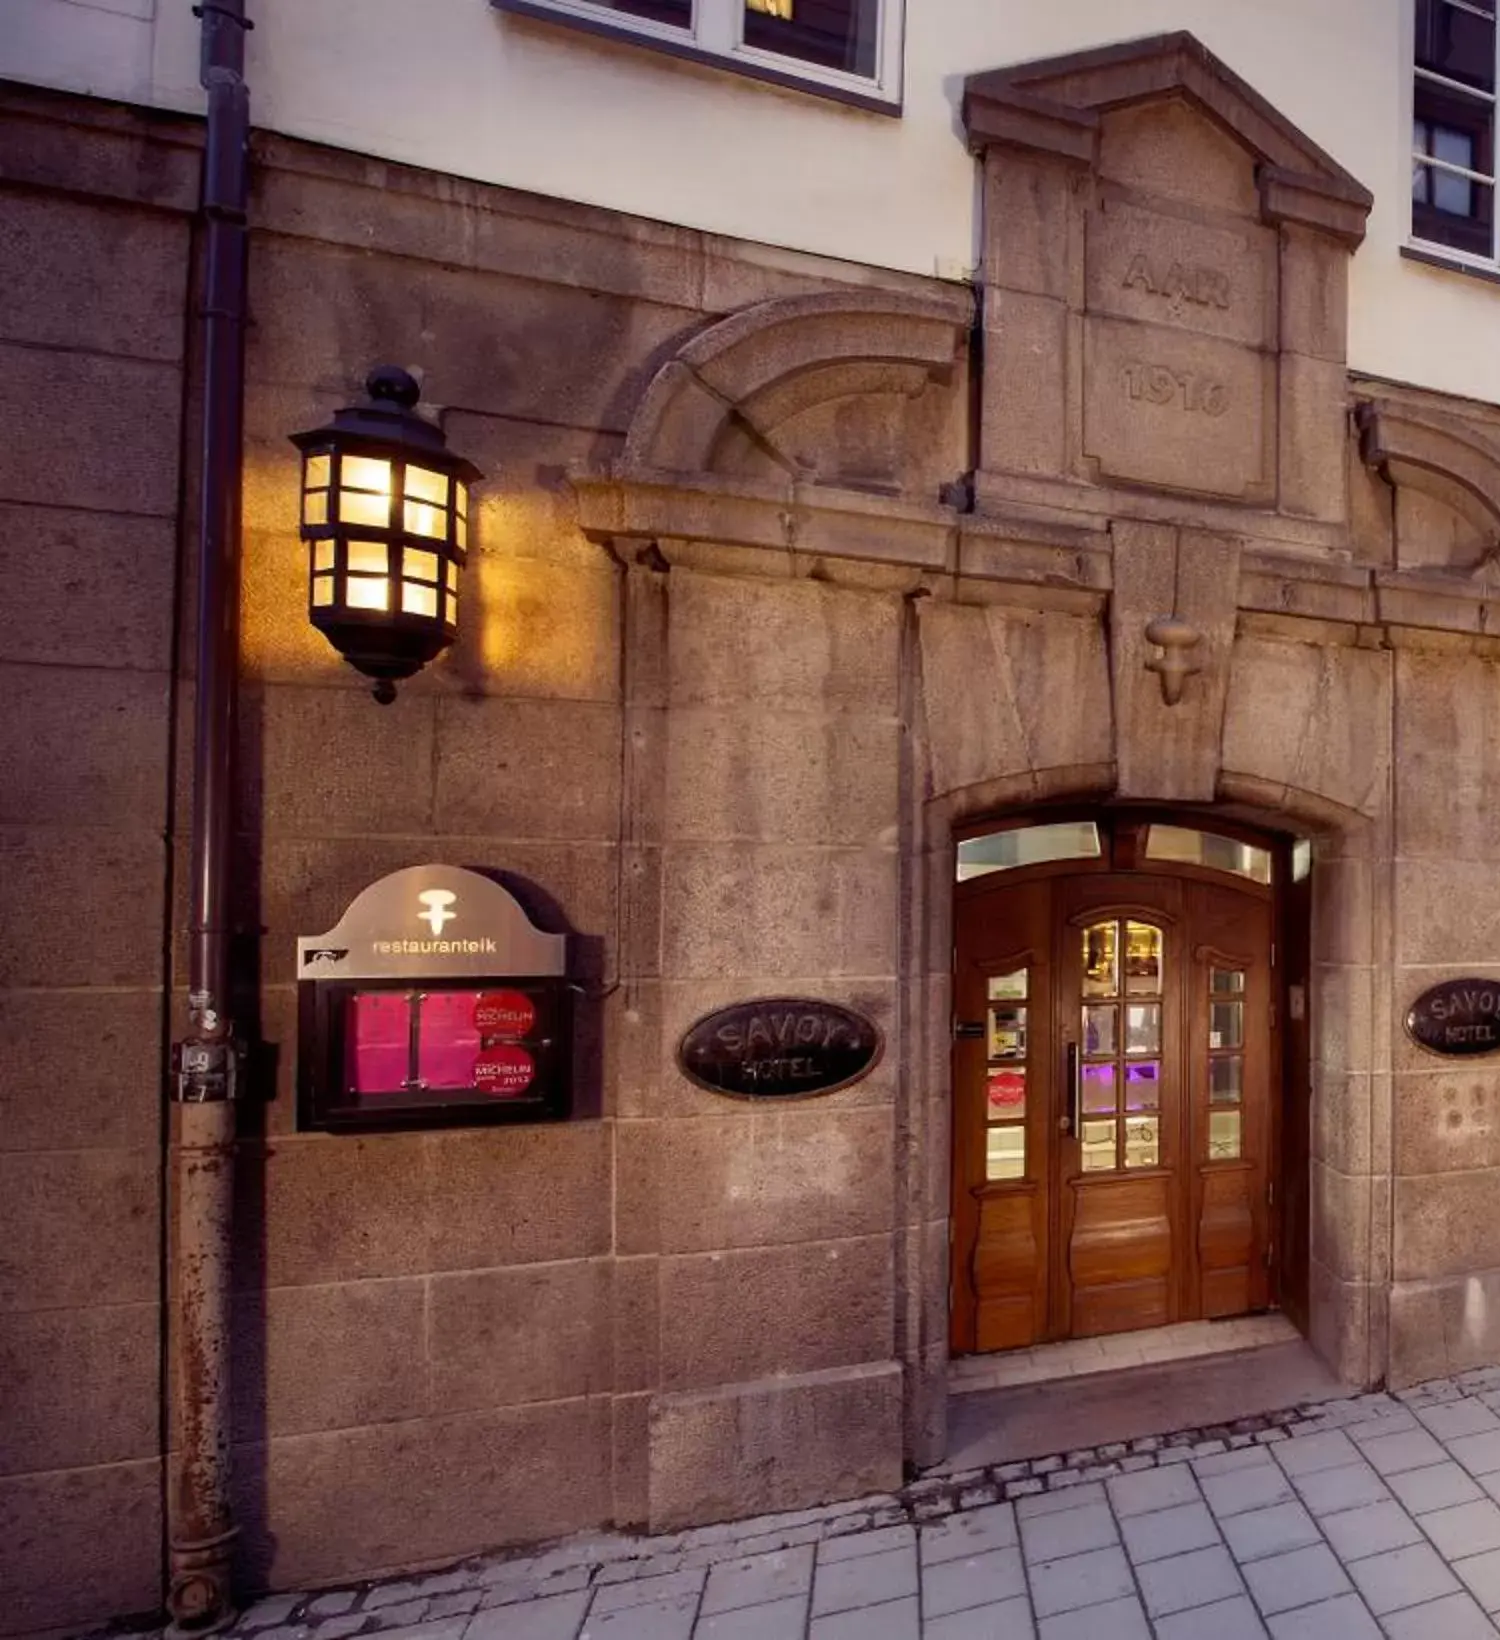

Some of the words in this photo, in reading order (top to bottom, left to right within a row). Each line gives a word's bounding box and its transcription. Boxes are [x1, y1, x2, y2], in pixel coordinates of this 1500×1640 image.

[1124, 361, 1230, 418] 1916
[716, 1012, 849, 1051] SAVOY
[1444, 1024, 1496, 1044] HOTEL
[475, 1065, 532, 1076] MICHELIN
[741, 1056, 823, 1080] HOTEL
